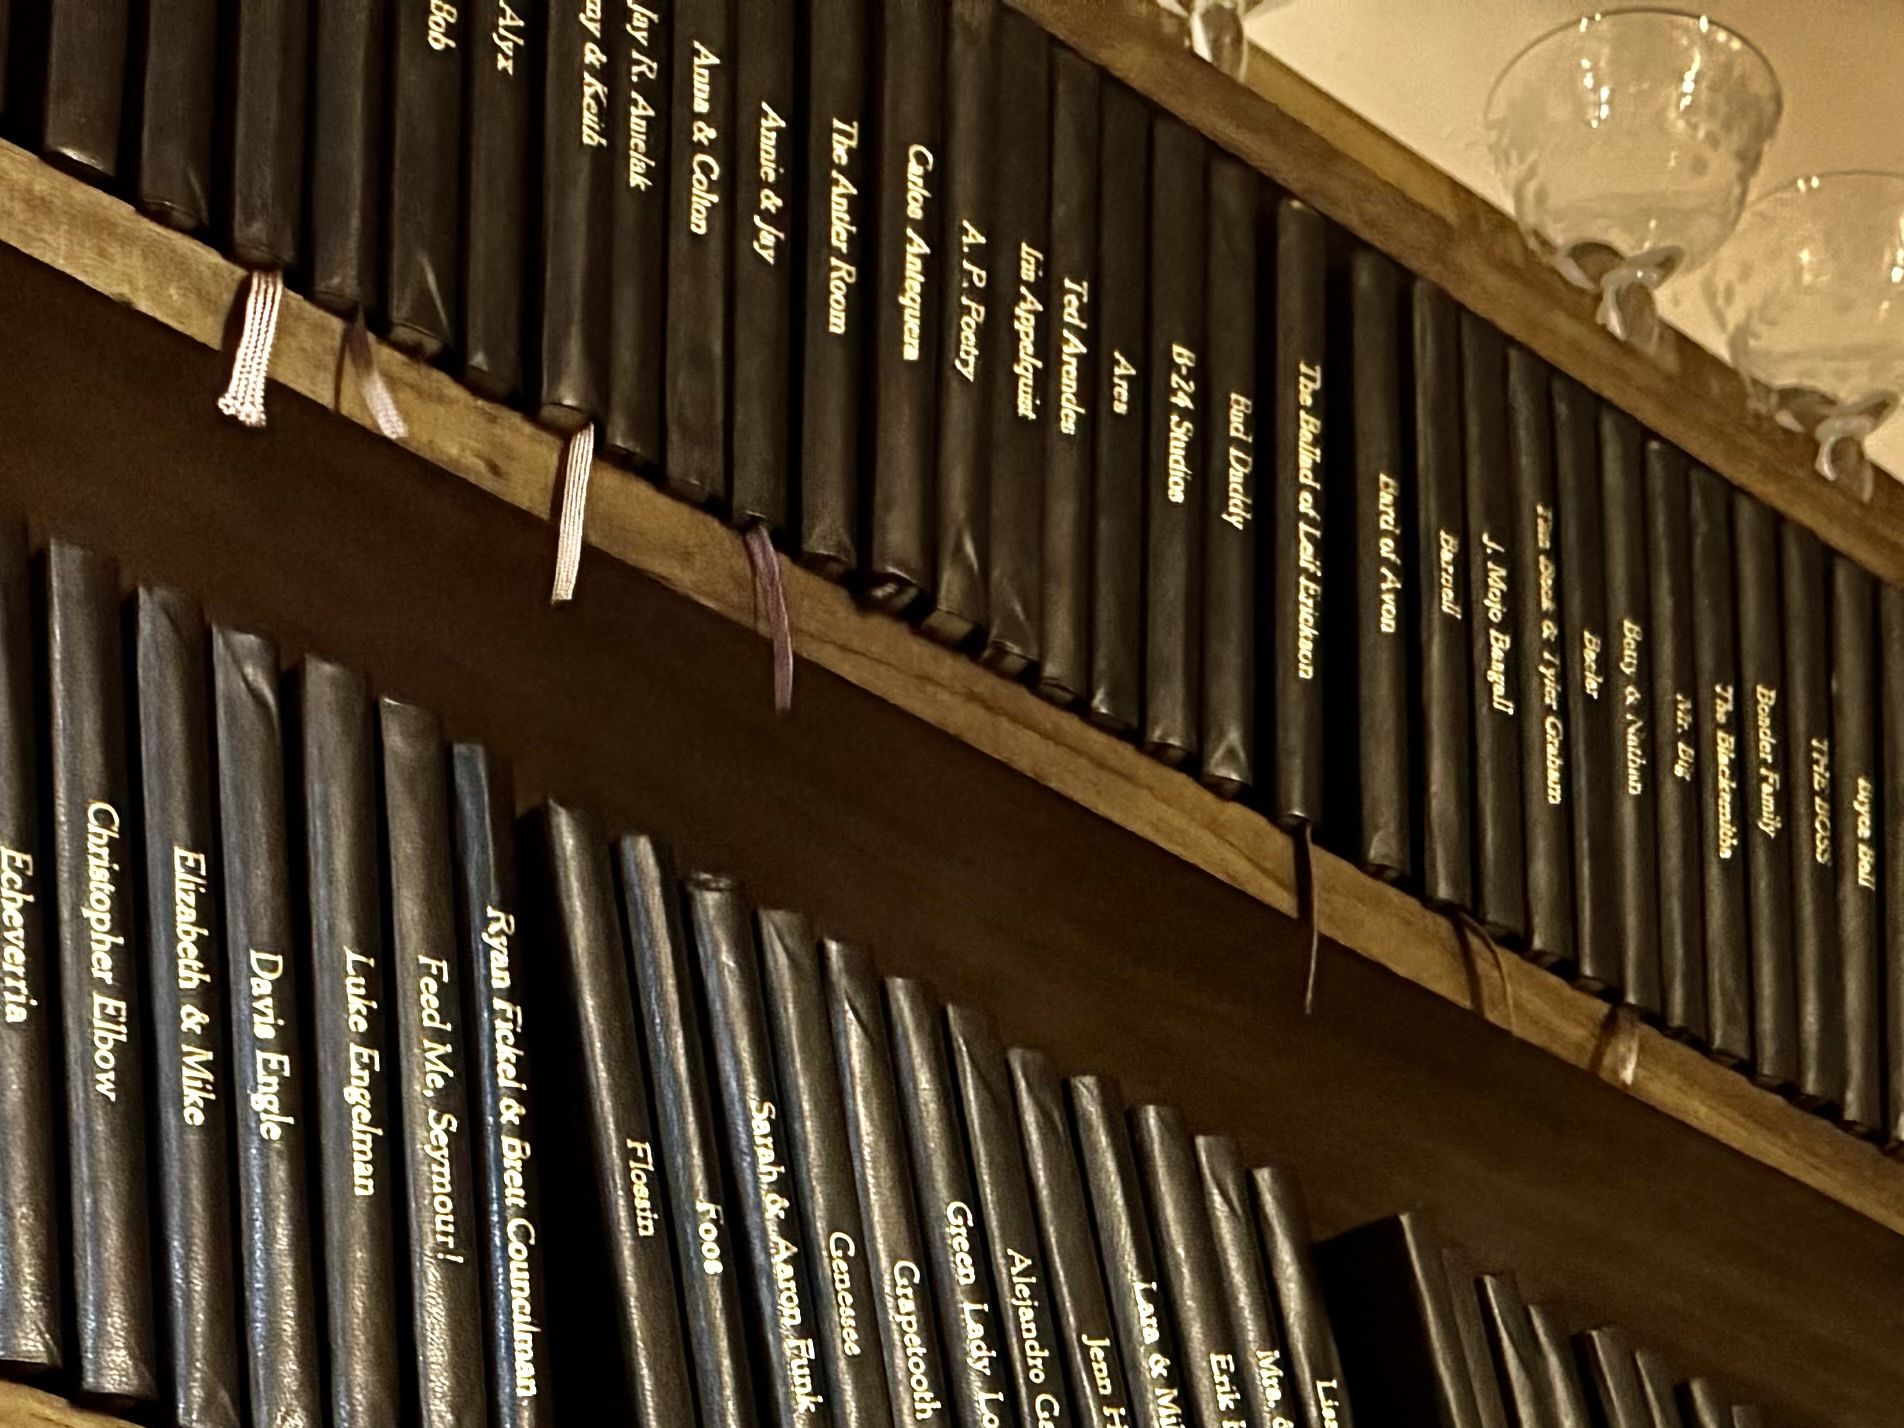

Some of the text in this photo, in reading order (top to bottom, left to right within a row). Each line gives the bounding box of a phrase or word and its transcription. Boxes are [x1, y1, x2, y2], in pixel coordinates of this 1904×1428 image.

[689, 39, 721, 235] Anna & Colton
[751, 100, 787, 265] Annie & Jay
[828, 116, 859, 335] The Antler Room
[897, 143, 934, 361] Carlos Antequera
[1378, 536, 1401, 565] of
[79, 800, 128, 1102] Christopher Elbow
[172, 844, 216, 1126] Elizabeth & Mike
[417, 953, 452, 1032] Feed
[342, 944, 383, 1196] Luke Engelman
[423, 1107, 464, 1264] Seymour!
[626, 1138, 659, 1236] Flossin
[887, 1259, 941, 1420] Grapetooth
[1005, 1247, 1050, 1384] Alejandro
